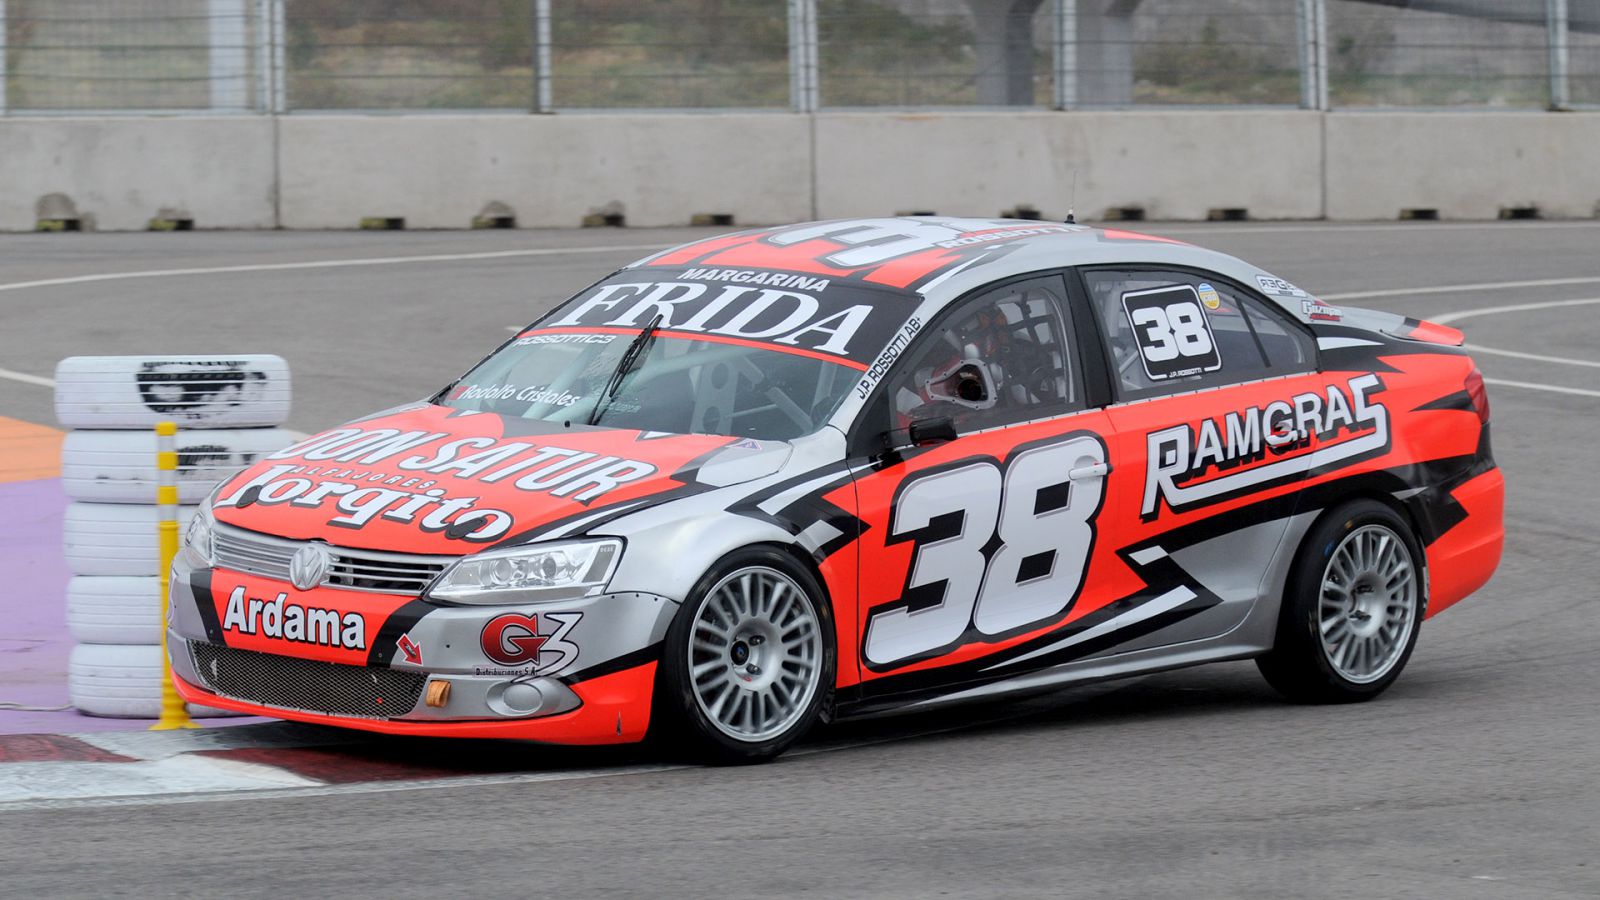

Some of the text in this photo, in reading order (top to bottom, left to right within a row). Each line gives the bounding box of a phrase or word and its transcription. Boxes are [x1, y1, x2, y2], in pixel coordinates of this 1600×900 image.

[676, 268, 830, 293] MARGARINA
[548, 282, 873, 355] FRIDA
[1132, 302, 1212, 362] 38
[867, 332, 909, 383] ROSSOTTI
[459, 384, 580, 406] Rodolfo Cristales
[266, 428, 657, 504] DON SATUR
[288, 464, 439, 490] ALFAJORES
[1140, 373, 1388, 516] RAMGRAS
[214, 463, 515, 543] Jorgito
[864, 435, 1105, 665] 38
[221, 585, 367, 651] Ardama
